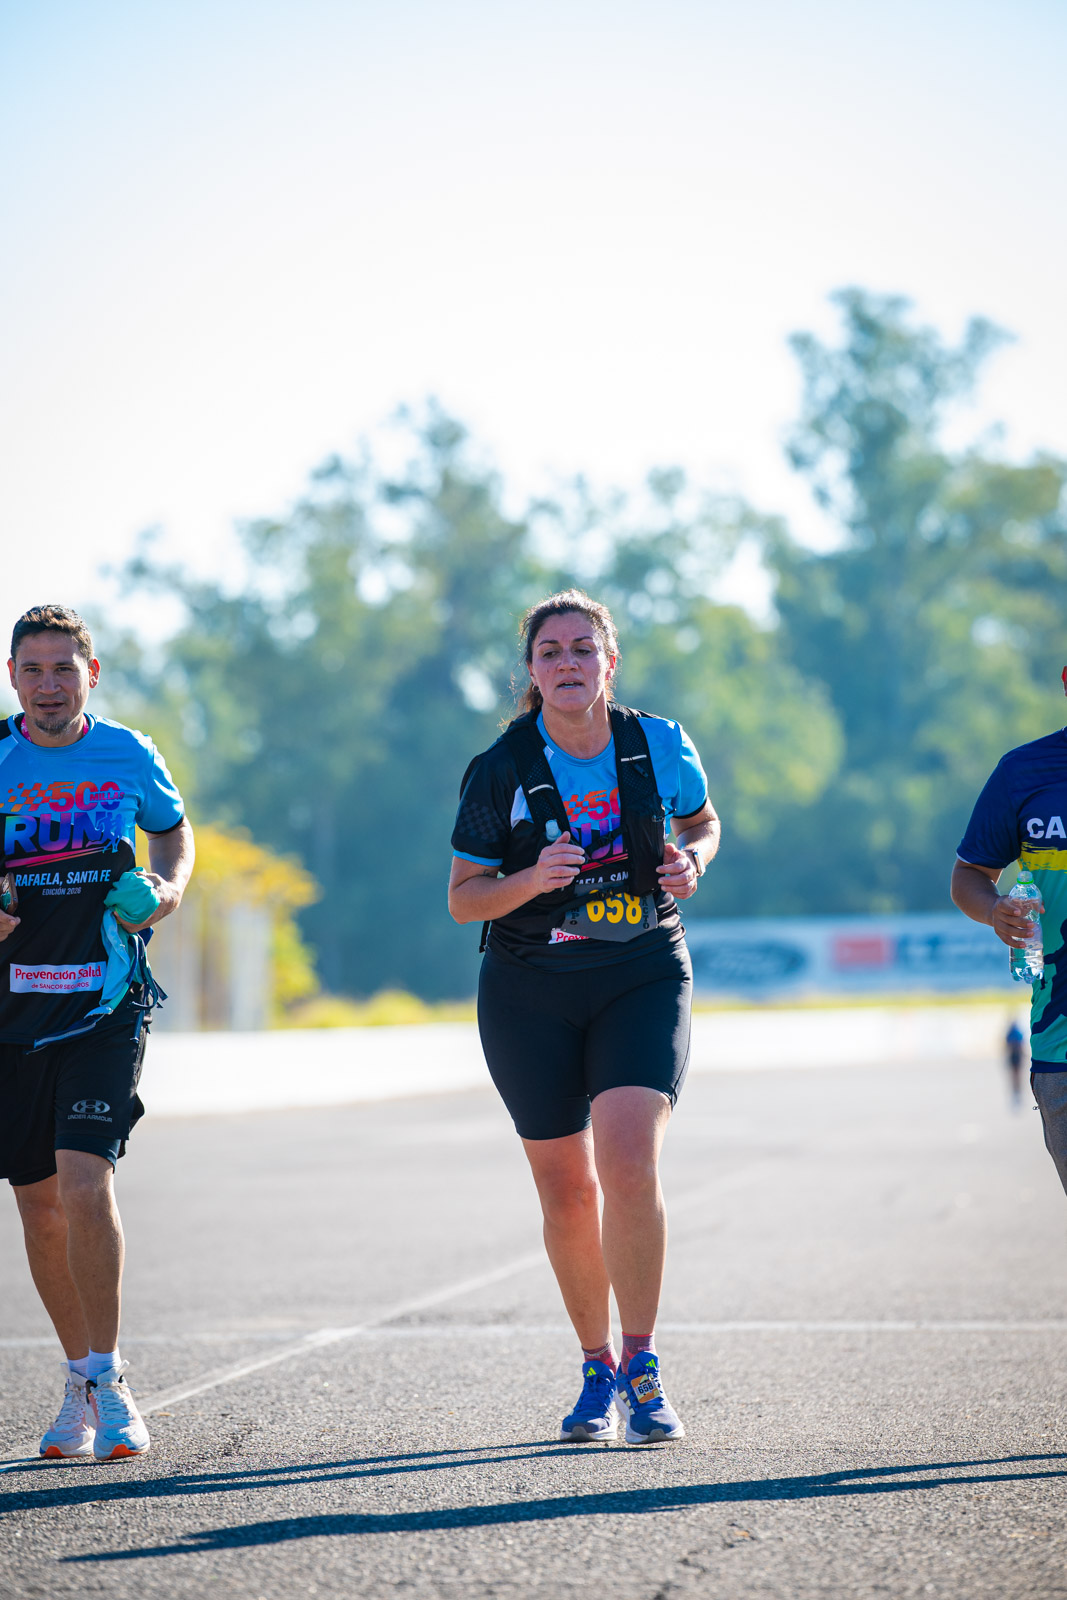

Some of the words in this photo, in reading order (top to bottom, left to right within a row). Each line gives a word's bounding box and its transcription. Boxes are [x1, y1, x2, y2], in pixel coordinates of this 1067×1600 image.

[49, 781, 120, 812] 500
[89, 792, 125, 801] MILLAS
[587, 787, 621, 821] 50
[4, 811, 112, 856] RUN
[15, 872, 63, 887] RAFAELA,
[66, 870, 99, 884] SANTA
[100, 869, 111, 882] FE
[42, 886, 66, 896] EDICIÓN
[586, 889, 642, 925] 658
[15, 967, 76, 981] Prevención
[638, 1382, 654, 1394] 658
